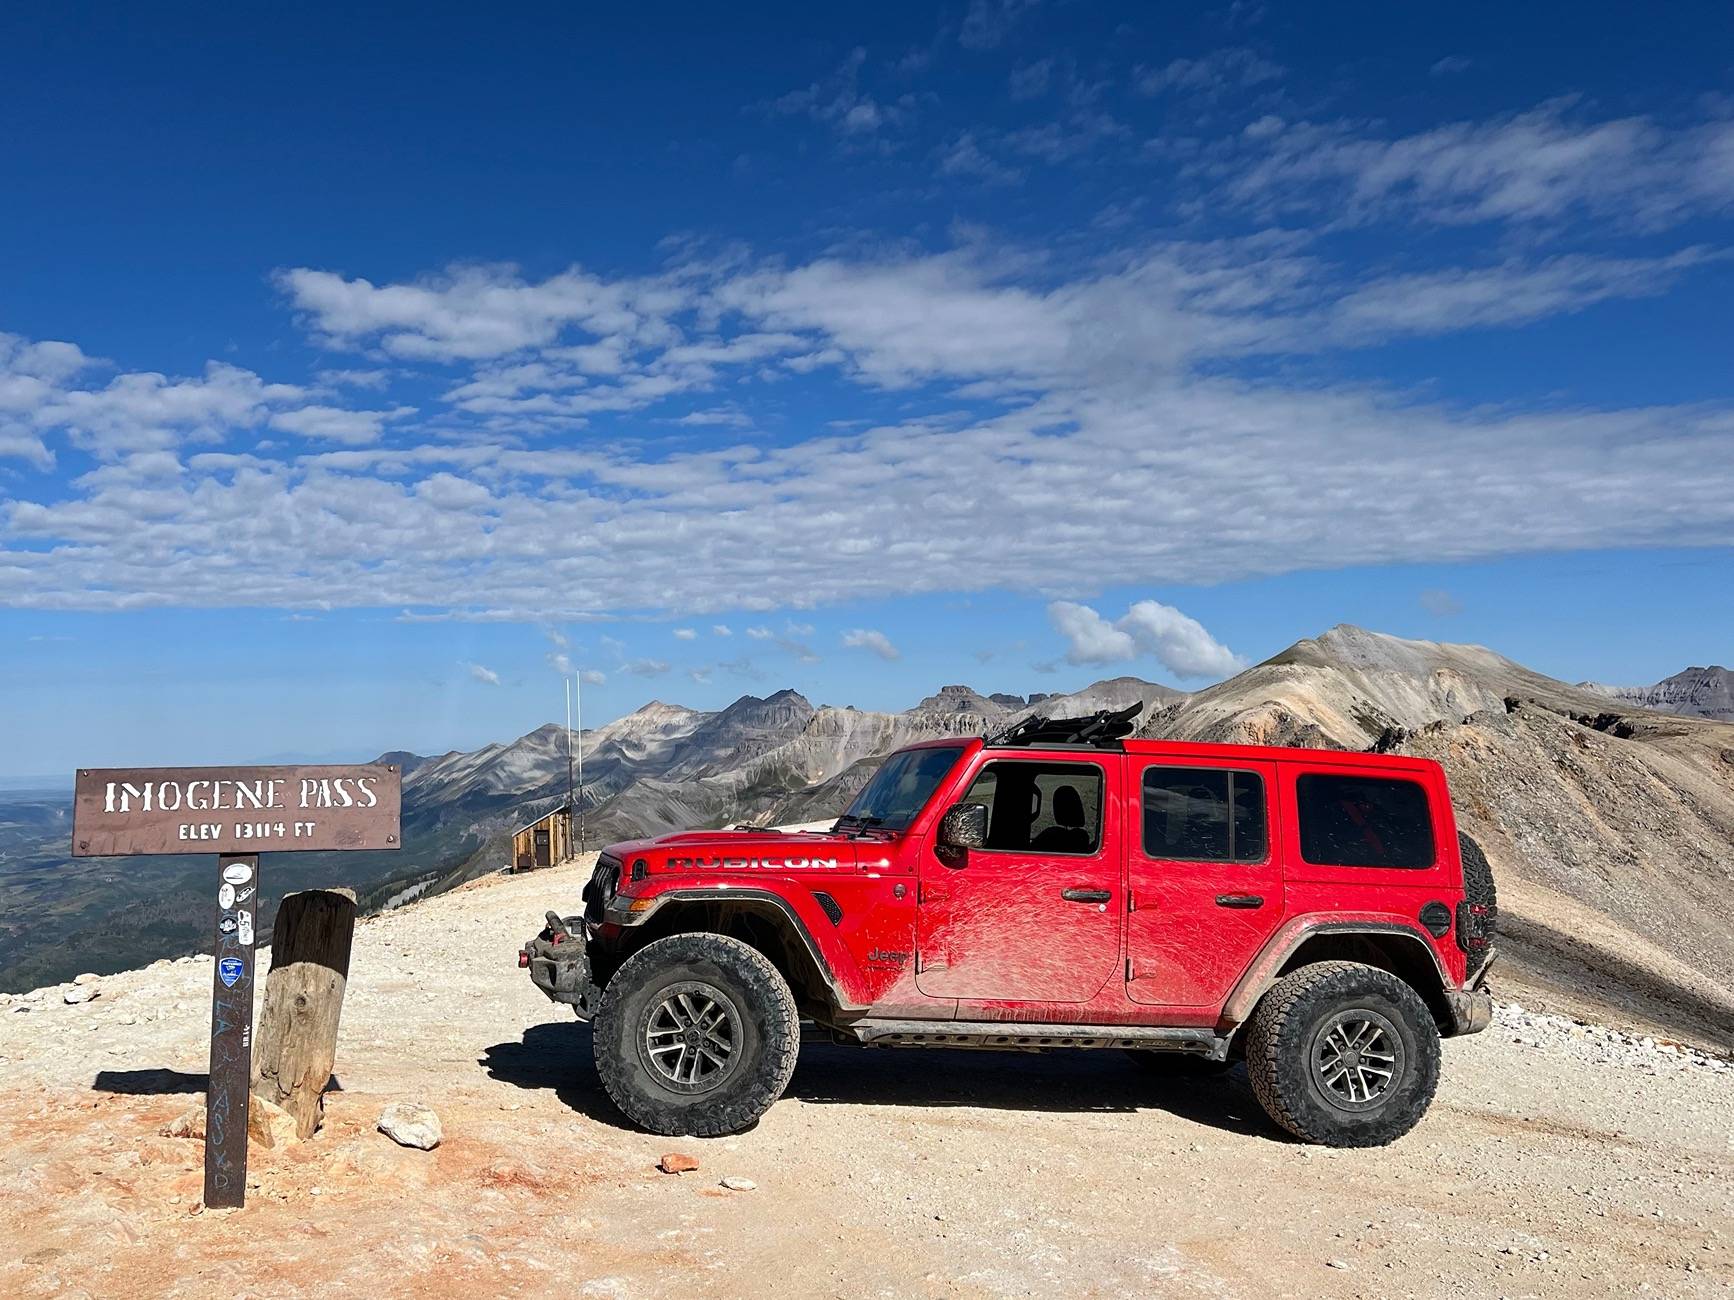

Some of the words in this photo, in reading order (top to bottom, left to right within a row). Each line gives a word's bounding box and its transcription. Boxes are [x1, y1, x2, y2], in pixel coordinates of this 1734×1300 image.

[103, 778, 285, 813] IMOGENE
[299, 777, 378, 808] PASS
[178, 823, 222, 840] ELEV
[234, 822, 286, 839] 13114
[294, 821, 316, 837] FT
[667, 857, 838, 869] RUBICON
[868, 946, 908, 965] Jeep
